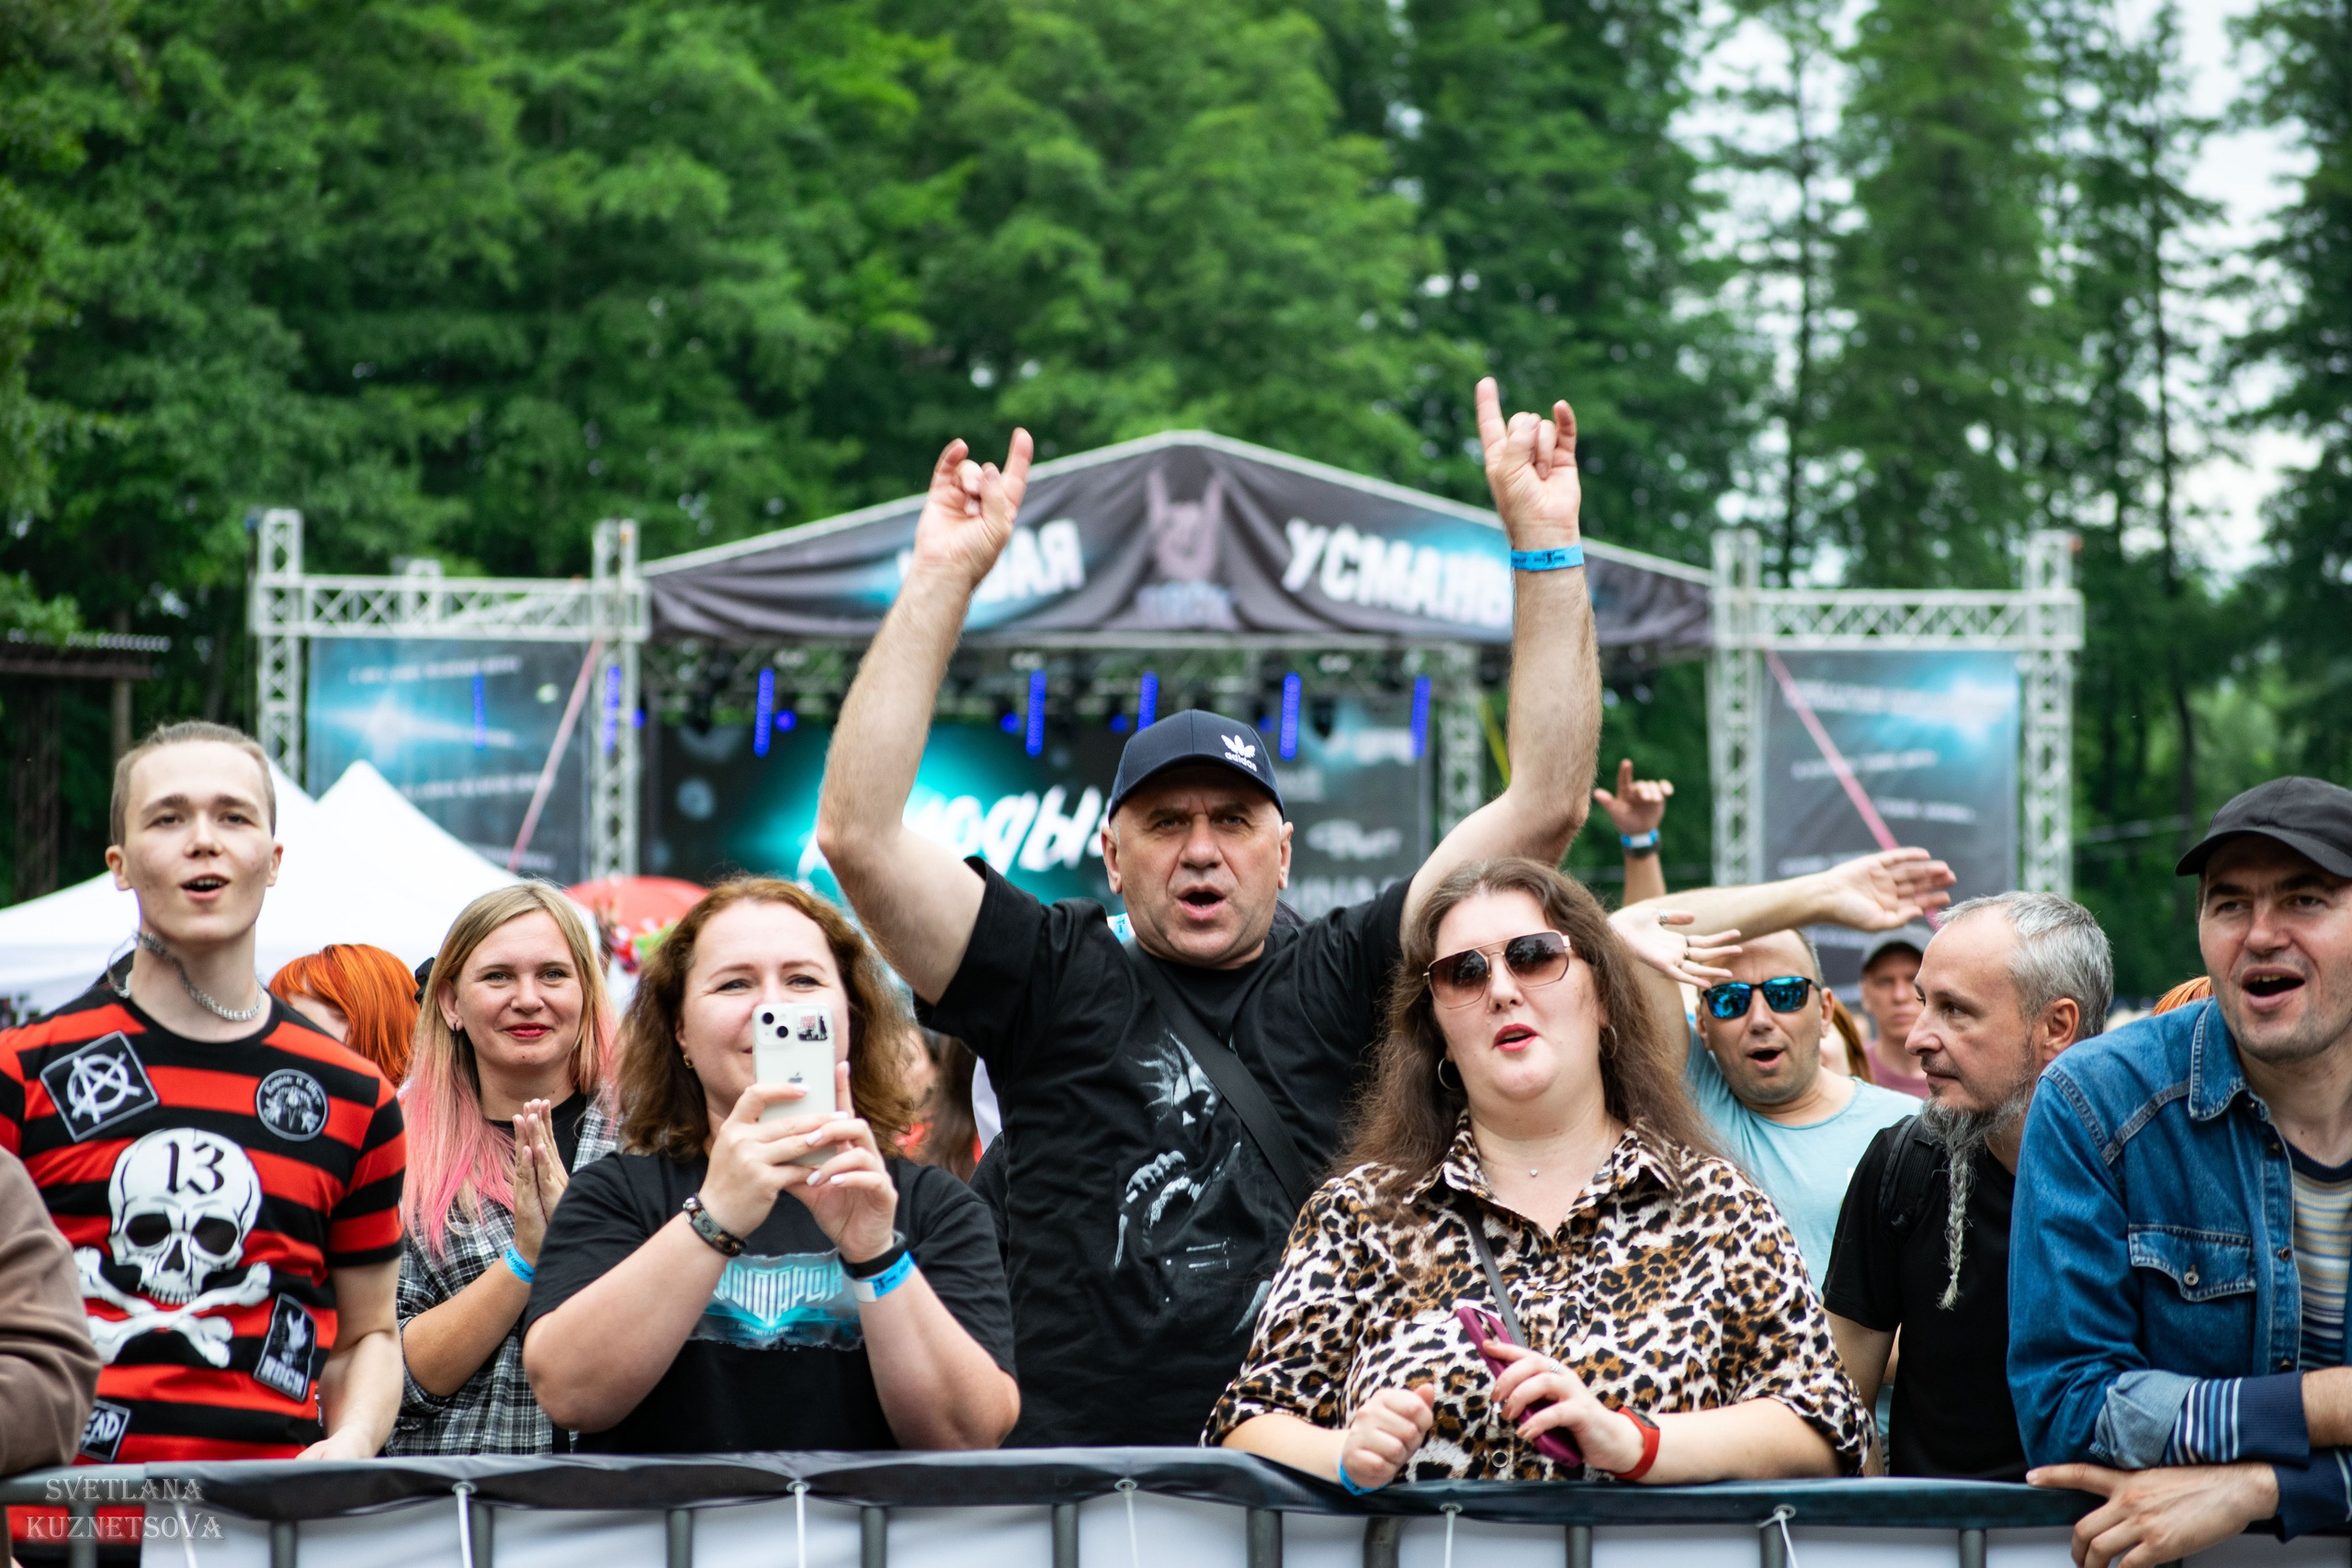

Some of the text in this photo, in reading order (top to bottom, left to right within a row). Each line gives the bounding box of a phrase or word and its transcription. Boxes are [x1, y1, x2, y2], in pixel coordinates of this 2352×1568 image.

[1225, 751, 1258, 773] adidas
[163, 1139, 225, 1195] 13
[81, 1408, 121, 1446] EAD
